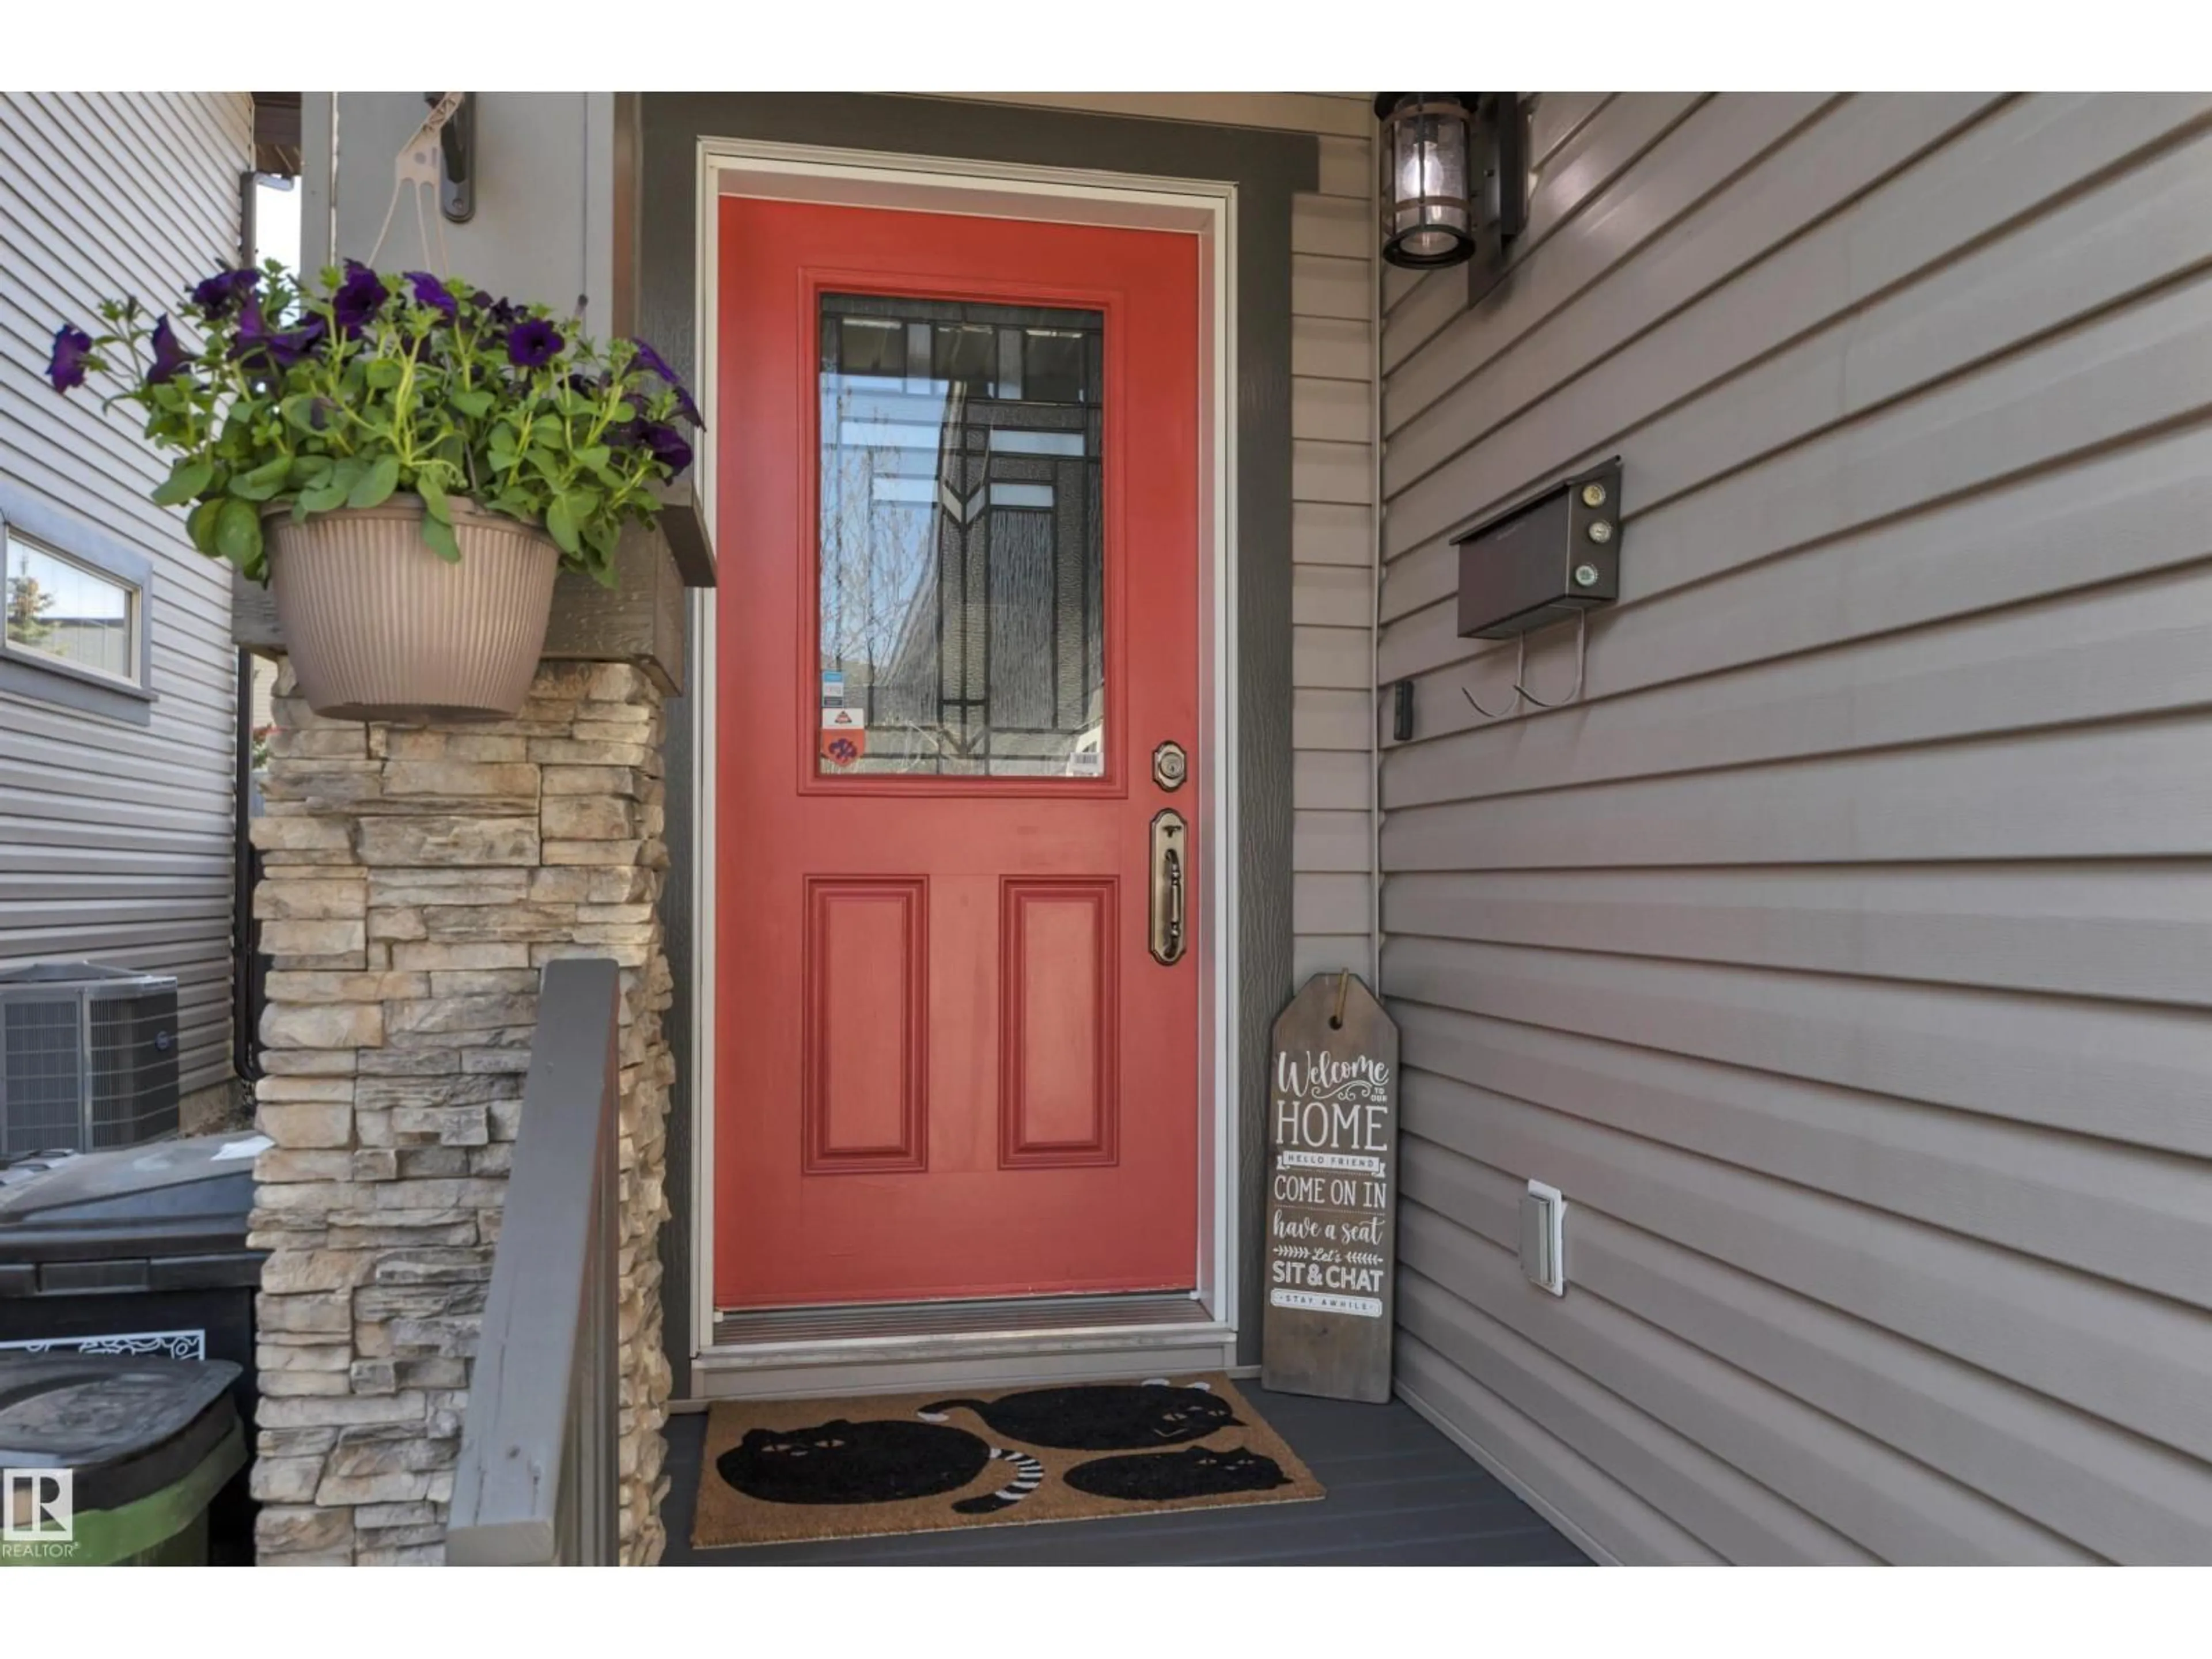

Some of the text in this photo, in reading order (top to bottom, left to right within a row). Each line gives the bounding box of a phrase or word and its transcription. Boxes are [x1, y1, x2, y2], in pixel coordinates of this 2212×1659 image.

[1278, 1050, 1389, 1097] Welcome
[1276, 1100, 1388, 1151] HOME
[1288, 1154, 1374, 1168] HELLO FRIEND
[1274, 1175, 1387, 1209] COME ON IN
[1273, 1209, 1385, 1245] have a seat
[1312, 1247, 1342, 1263] Let's
[1285, 1294, 1313, 1304] STAY
